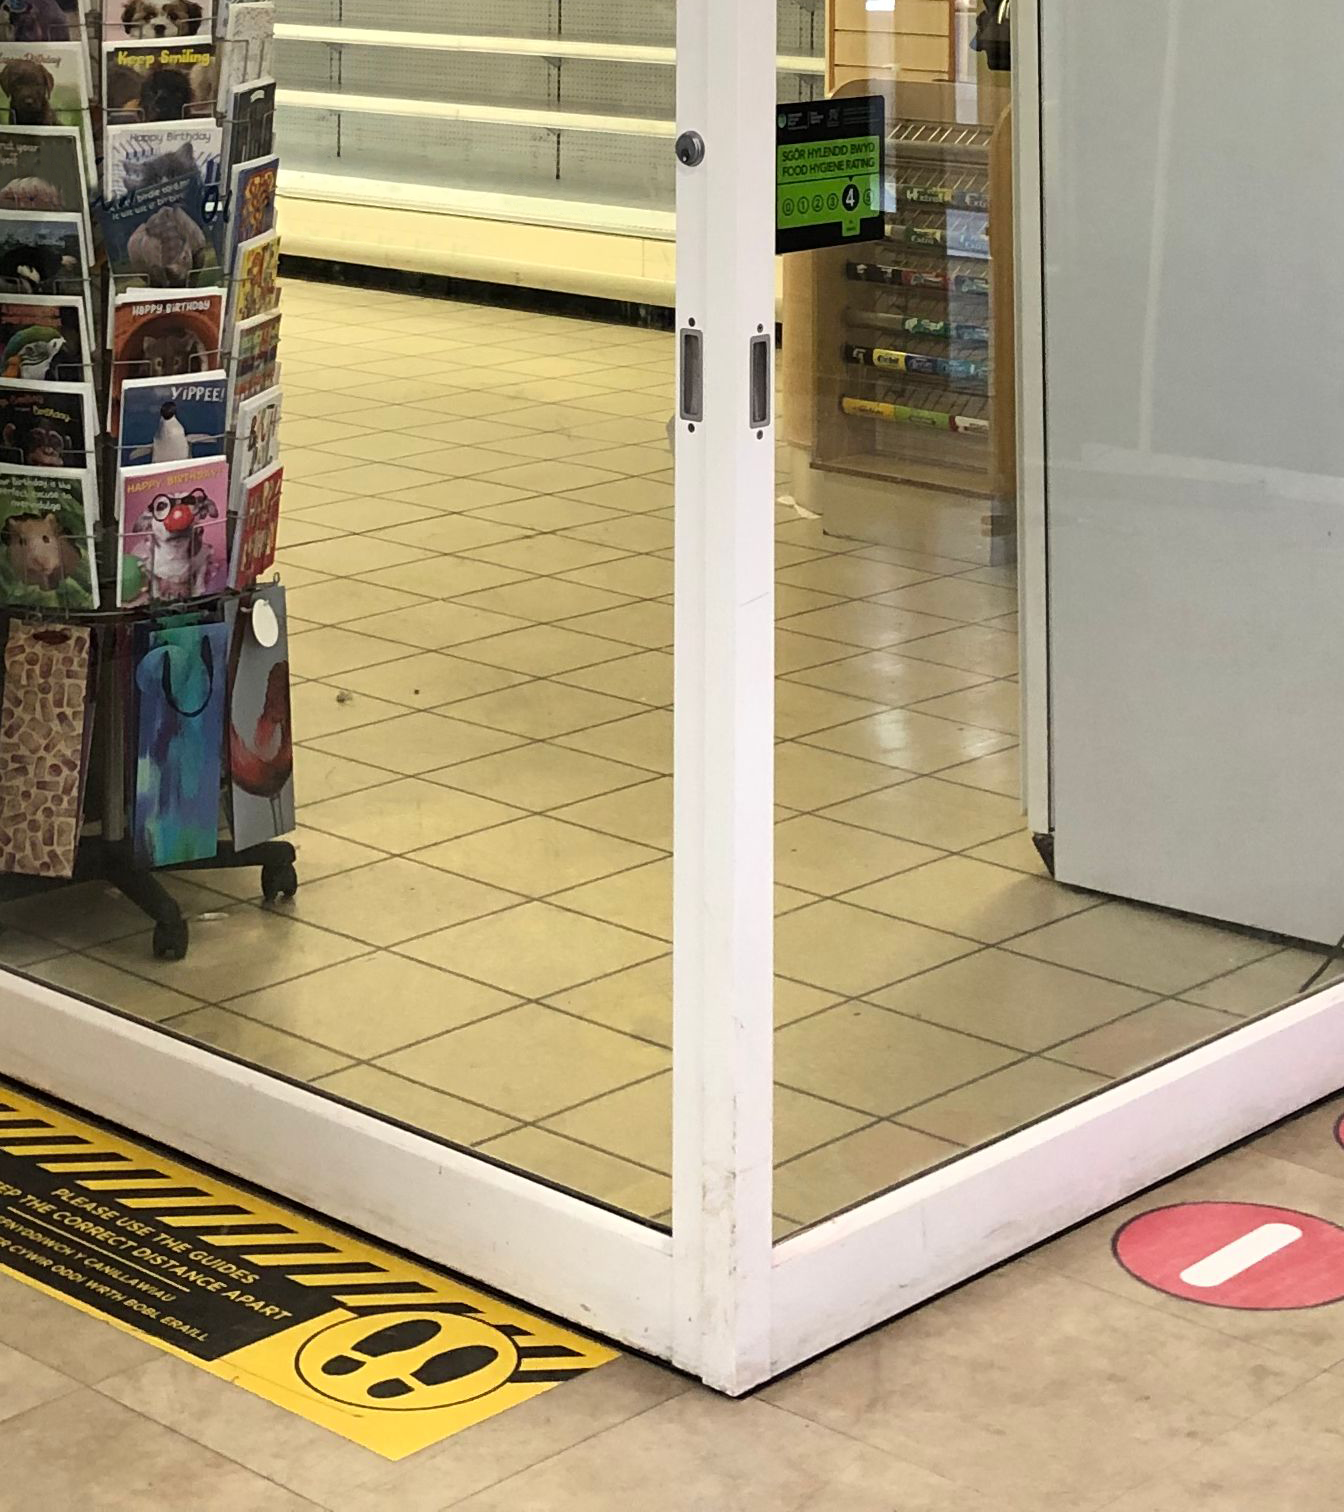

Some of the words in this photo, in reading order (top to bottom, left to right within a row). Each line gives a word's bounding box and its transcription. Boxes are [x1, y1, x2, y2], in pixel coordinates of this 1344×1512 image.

[118, 50, 155, 69] Keep
[160, 48, 210, 66] Smiling
[130, 133, 163, 145] Happy
[167, 132, 212, 144] Birthday
[782, 164, 808, 177] FOOD
[809, 161, 845, 174] HYGIENE
[846, 157, 875, 170] RATING
[132, 303, 164, 316] HAPPY
[128, 478, 161, 493] HAPPY
[50, 1188, 120, 1220] PLEASE
[115, 1216, 155, 1237] USE
[152, 1232, 193, 1254] THE
[188, 1250, 260, 1285] GUIDES
[9, 1245, 54, 1267] CYWIR
[19, 1194, 58, 1214] THE
[52, 1211, 138, 1250] CORRECT
[131, 1247, 228, 1293] DISTANCE
[221, 1289, 293, 1321] APART
